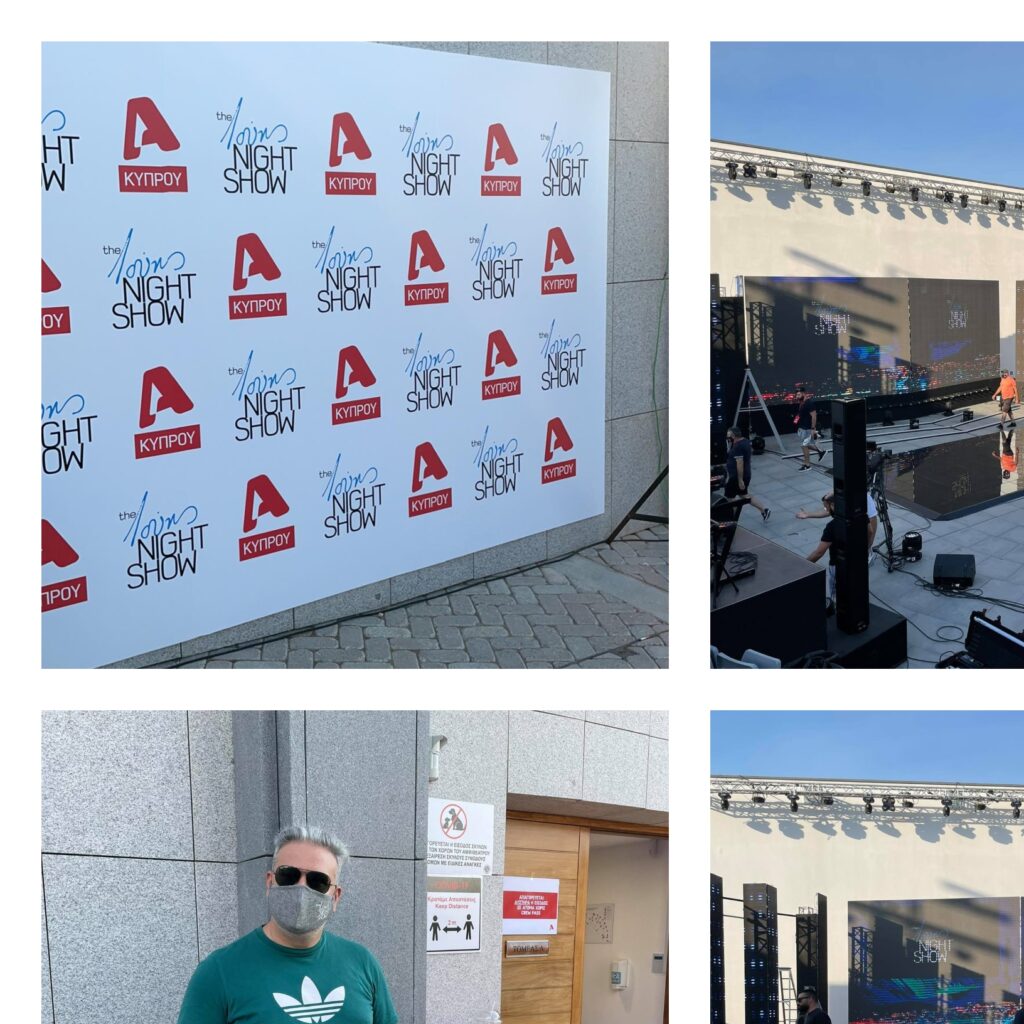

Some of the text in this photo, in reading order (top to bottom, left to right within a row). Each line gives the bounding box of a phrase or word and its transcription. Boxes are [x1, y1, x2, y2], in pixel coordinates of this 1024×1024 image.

[216, 112, 232, 121] the
[399, 124, 412, 133] the
[540, 133, 551, 141] the
[233, 144, 298, 171] NIGHT
[411, 153, 460, 176] NIGHT
[550, 158, 589, 178] NIGHT
[124, 172, 182, 187] ΚΥΠΡΟΥ
[224, 168, 287, 194] SHOW
[329, 178, 373, 191] ΚΥΠΡΟΥ
[403, 174, 452, 196] SHOW
[484, 180, 519, 192] ΚΥΠΡΟΥ
[542, 176, 581, 197] SHOW
[103, 245, 121, 255] the
[312, 240, 326, 249] the
[469, 236, 480, 244] the
[325, 265, 381, 290] NIGHT
[479, 258, 523, 281] NIGHT
[123, 274, 196, 303] NIGHT
[407, 288, 446, 301] ΚΥΠΡΟΥ
[472, 278, 515, 300] SHOW
[543, 279, 575, 290] ΚΥΠΡΟΥ
[233, 298, 283, 314] ΚΥΠΡΟΥ
[317, 287, 372, 312] SHOW
[112, 298, 184, 329] SHOW
[402, 347, 414, 355] the
[547, 349, 587, 372] NIGHT
[228, 367, 244, 376] the
[414, 365, 462, 391] NIGHT
[541, 368, 580, 391] SHOW
[406, 386, 454, 412] SHOW
[484, 381, 519, 396] ΚΥΠΡΟΥ
[244, 387, 305, 418] NIGHT
[335, 402, 377, 419] ΚΥΠΡΟΥ
[234, 410, 295, 441] SHOW
[140, 431, 196, 452] ΚΥΠΡΟΥ
[319, 470, 332, 478] the
[481, 453, 524, 479] NIGHT
[543, 463, 574, 480] ΚΥΠΡΟΥ
[474, 473, 517, 501] SHOW
[332, 483, 386, 517] NIGHT
[411, 493, 449, 512] ΚΥΠΡΟΥ
[119, 511, 137, 520] the
[324, 506, 377, 539] SHOW
[138, 524, 208, 563] NIGHT
[243, 532, 290, 556] ΚΥΠΡΟΥ
[127, 550, 197, 589] SHOW
